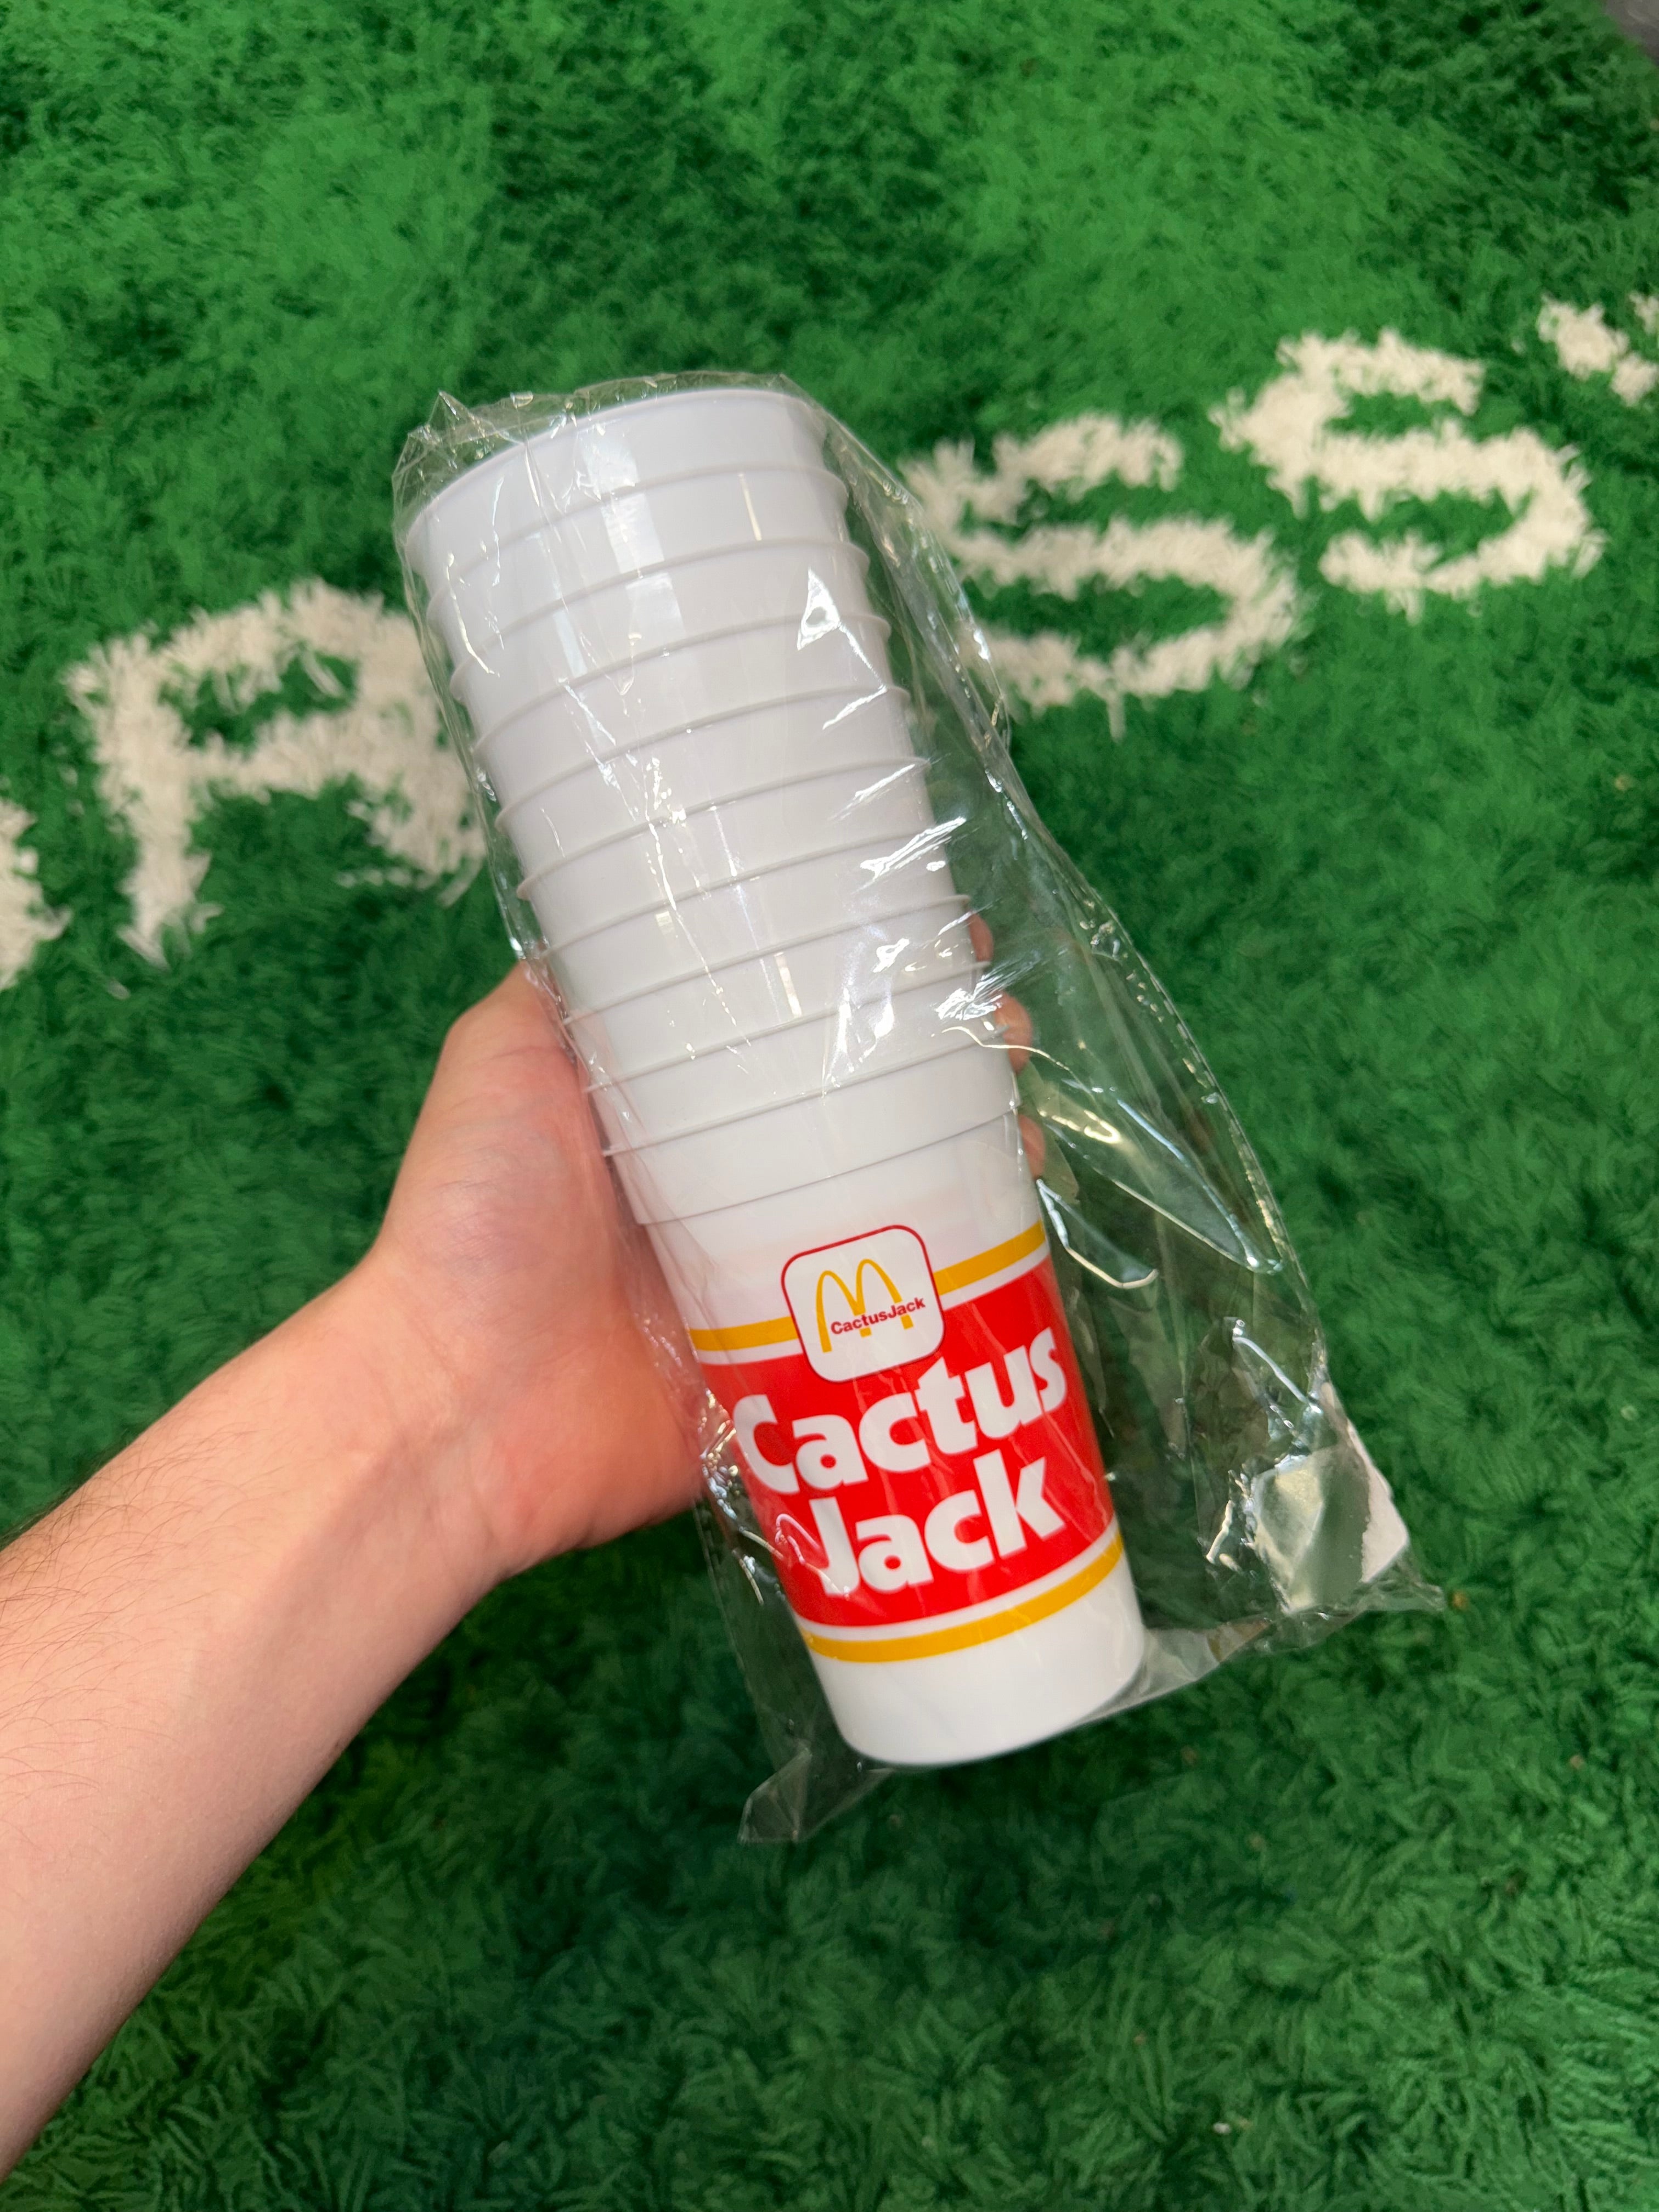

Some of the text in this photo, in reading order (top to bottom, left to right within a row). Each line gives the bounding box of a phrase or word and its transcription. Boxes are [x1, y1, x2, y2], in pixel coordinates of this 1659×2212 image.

[830, 1297, 926, 1335] CactusJack
[732, 1327, 1067, 1495] Cactus
[809, 1449, 1066, 1596] Jack
